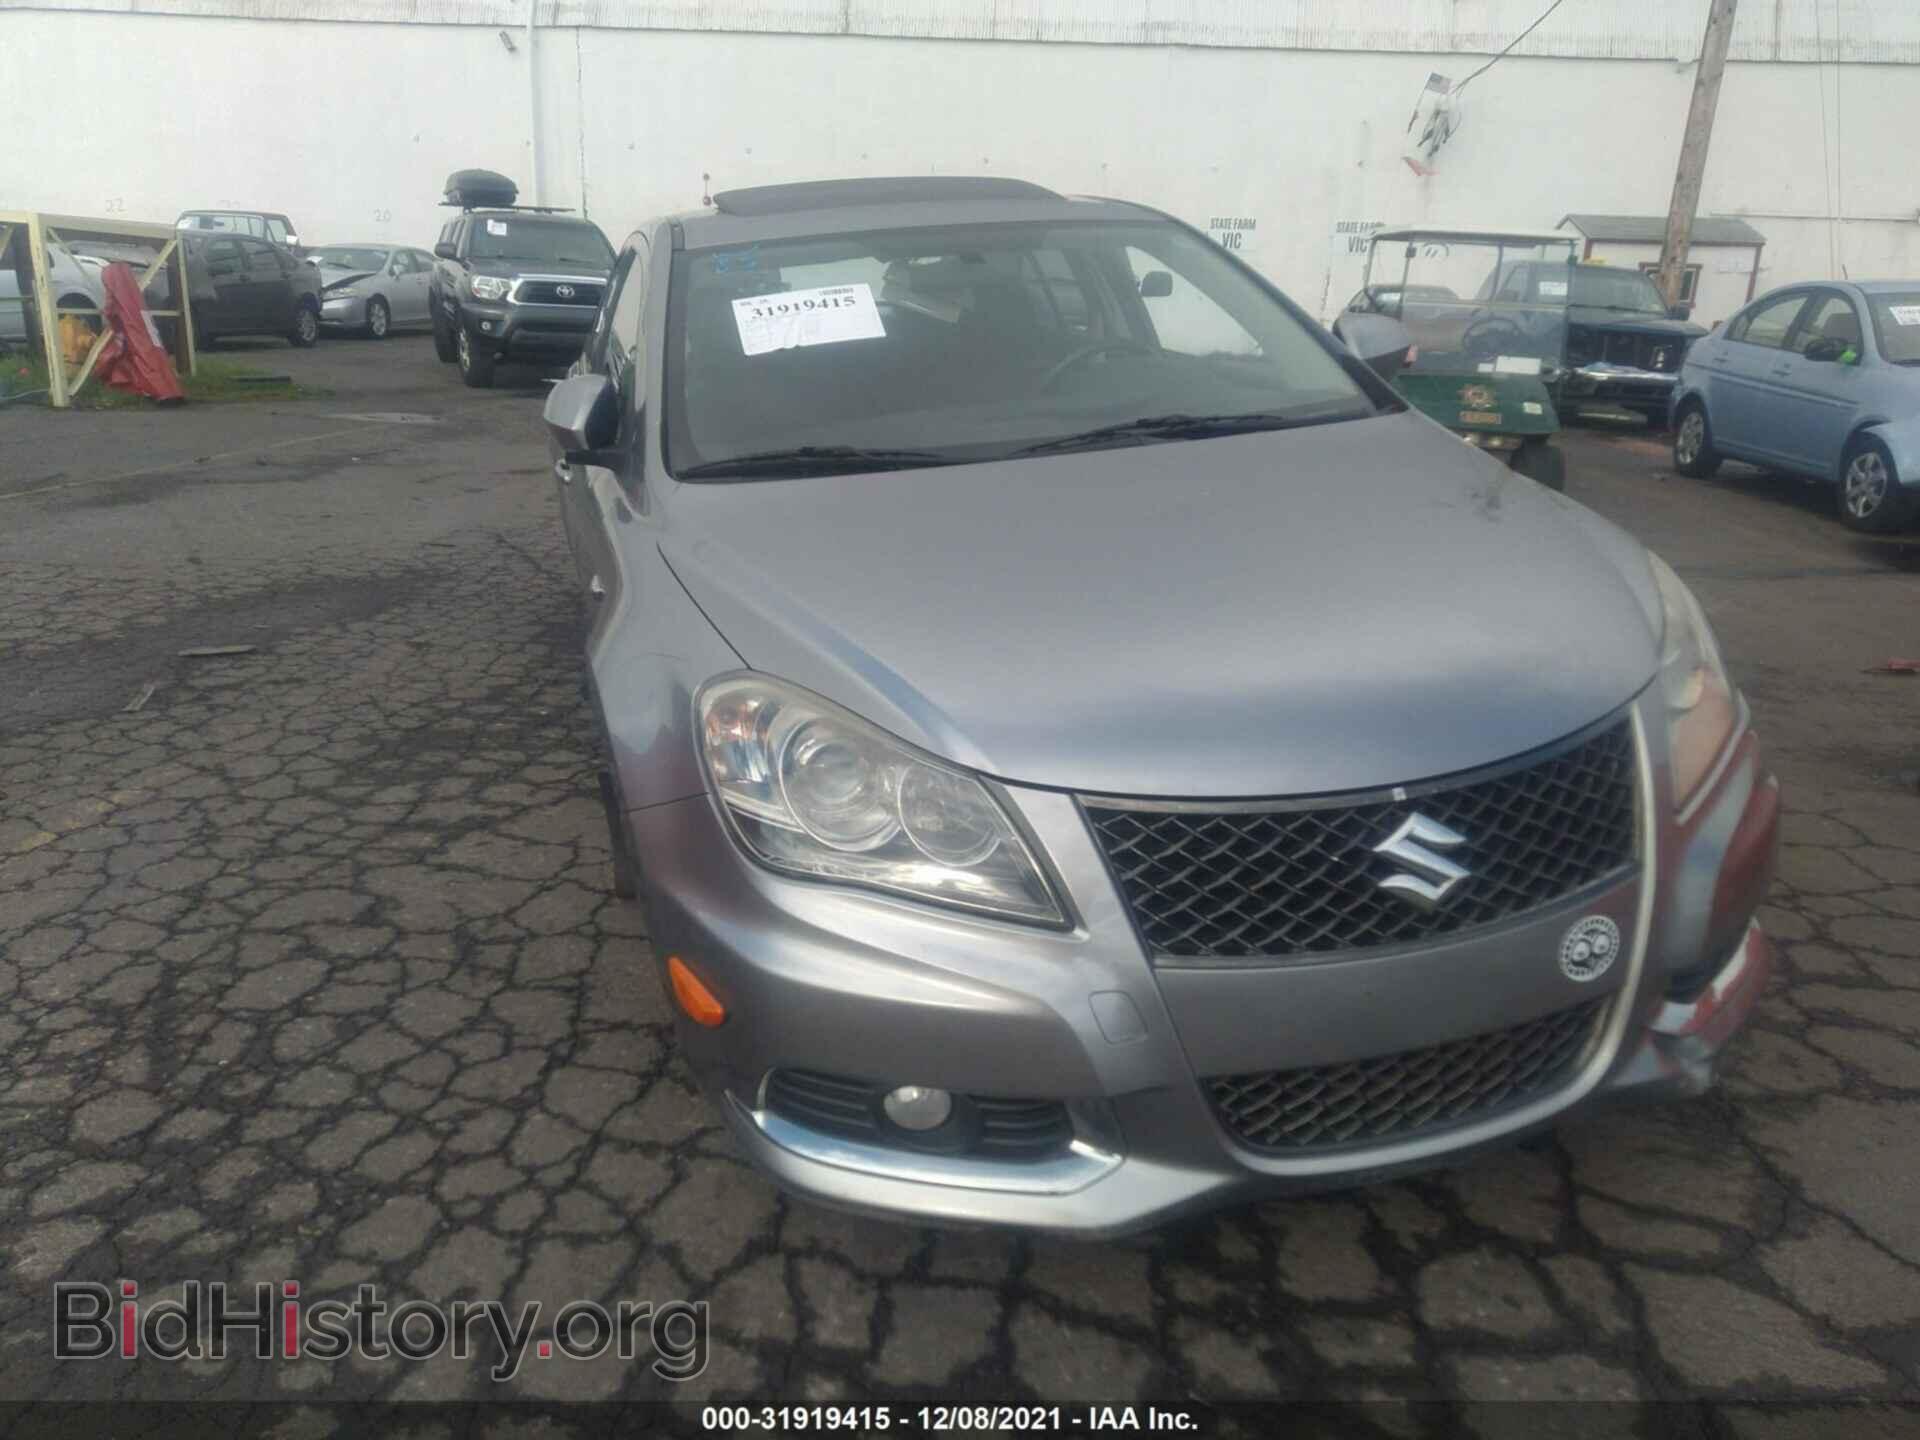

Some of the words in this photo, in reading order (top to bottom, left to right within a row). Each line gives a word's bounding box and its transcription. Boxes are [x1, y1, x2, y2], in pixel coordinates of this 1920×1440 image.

[1210, 217, 1232, 230] STATE
[1233, 217, 1257, 230] FARM
[1335, 221, 1357, 234] STATE
[1222, 231, 1242, 249] VIC
[1348, 235, 1369, 253] VIC
[751, 295, 857, 320] 31919415
